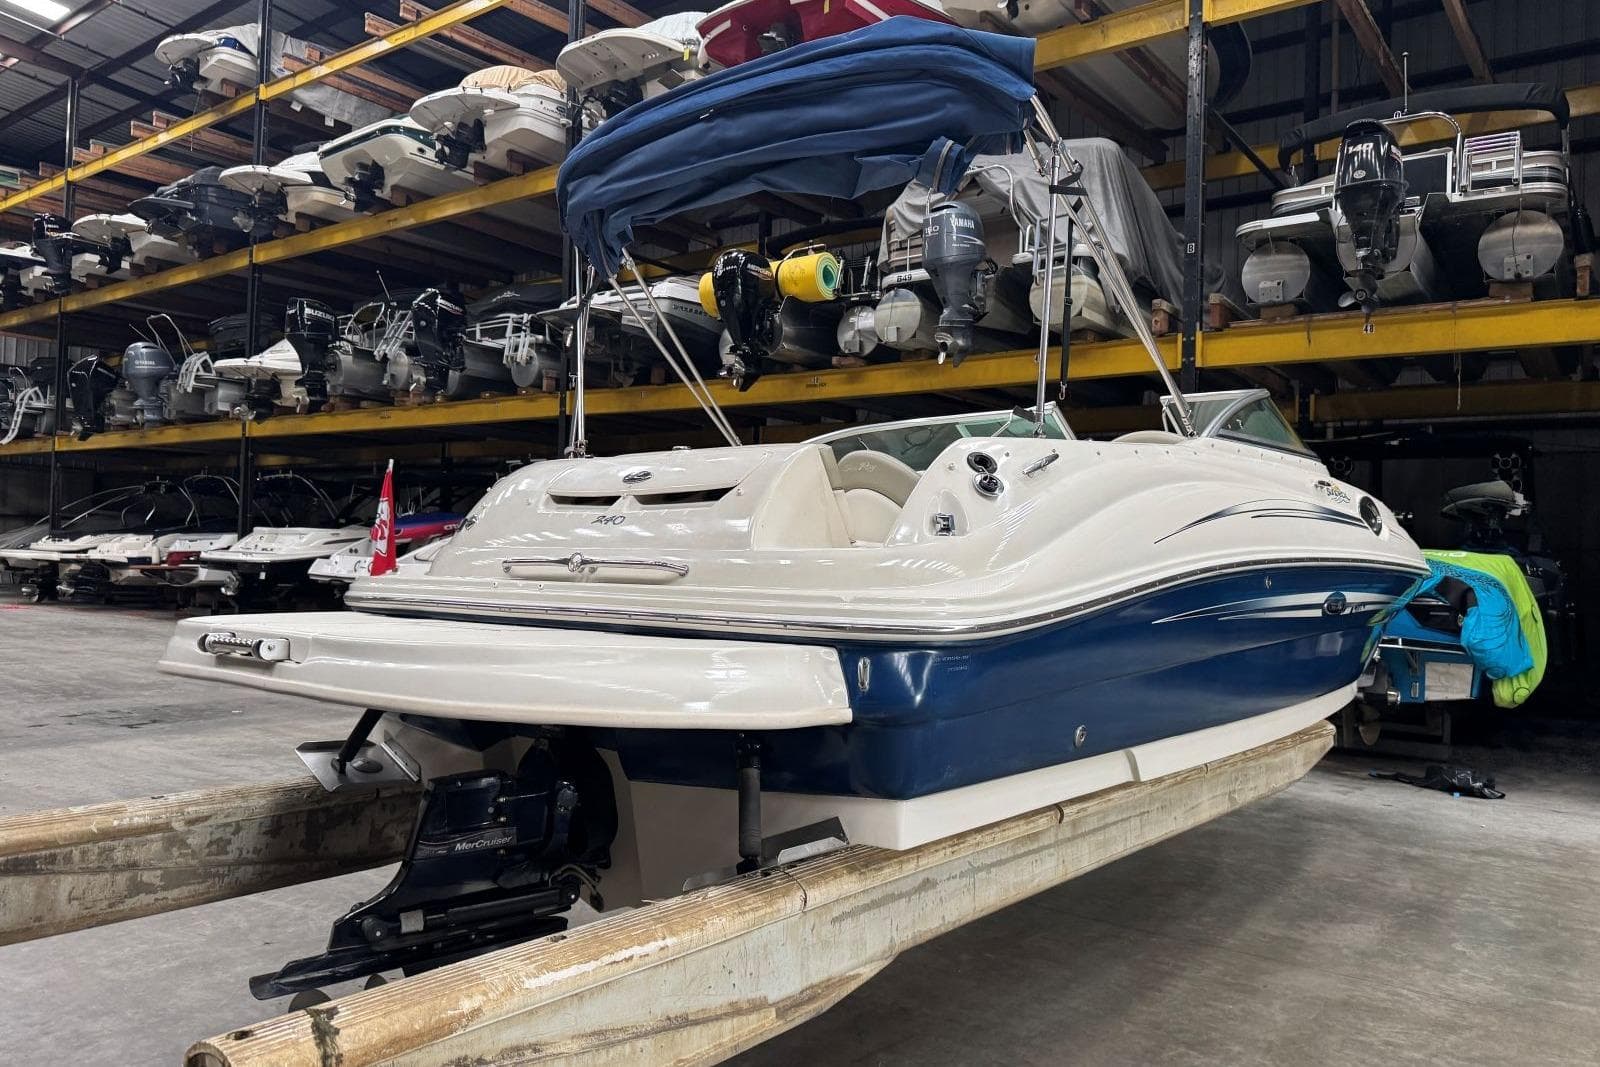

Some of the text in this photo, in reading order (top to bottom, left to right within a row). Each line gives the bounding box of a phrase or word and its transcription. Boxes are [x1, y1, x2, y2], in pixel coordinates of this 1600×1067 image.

[950, 217, 974, 230] YAMAHA
[591, 515, 626, 525] 240
[455, 836, 513, 851] MerCruiser
